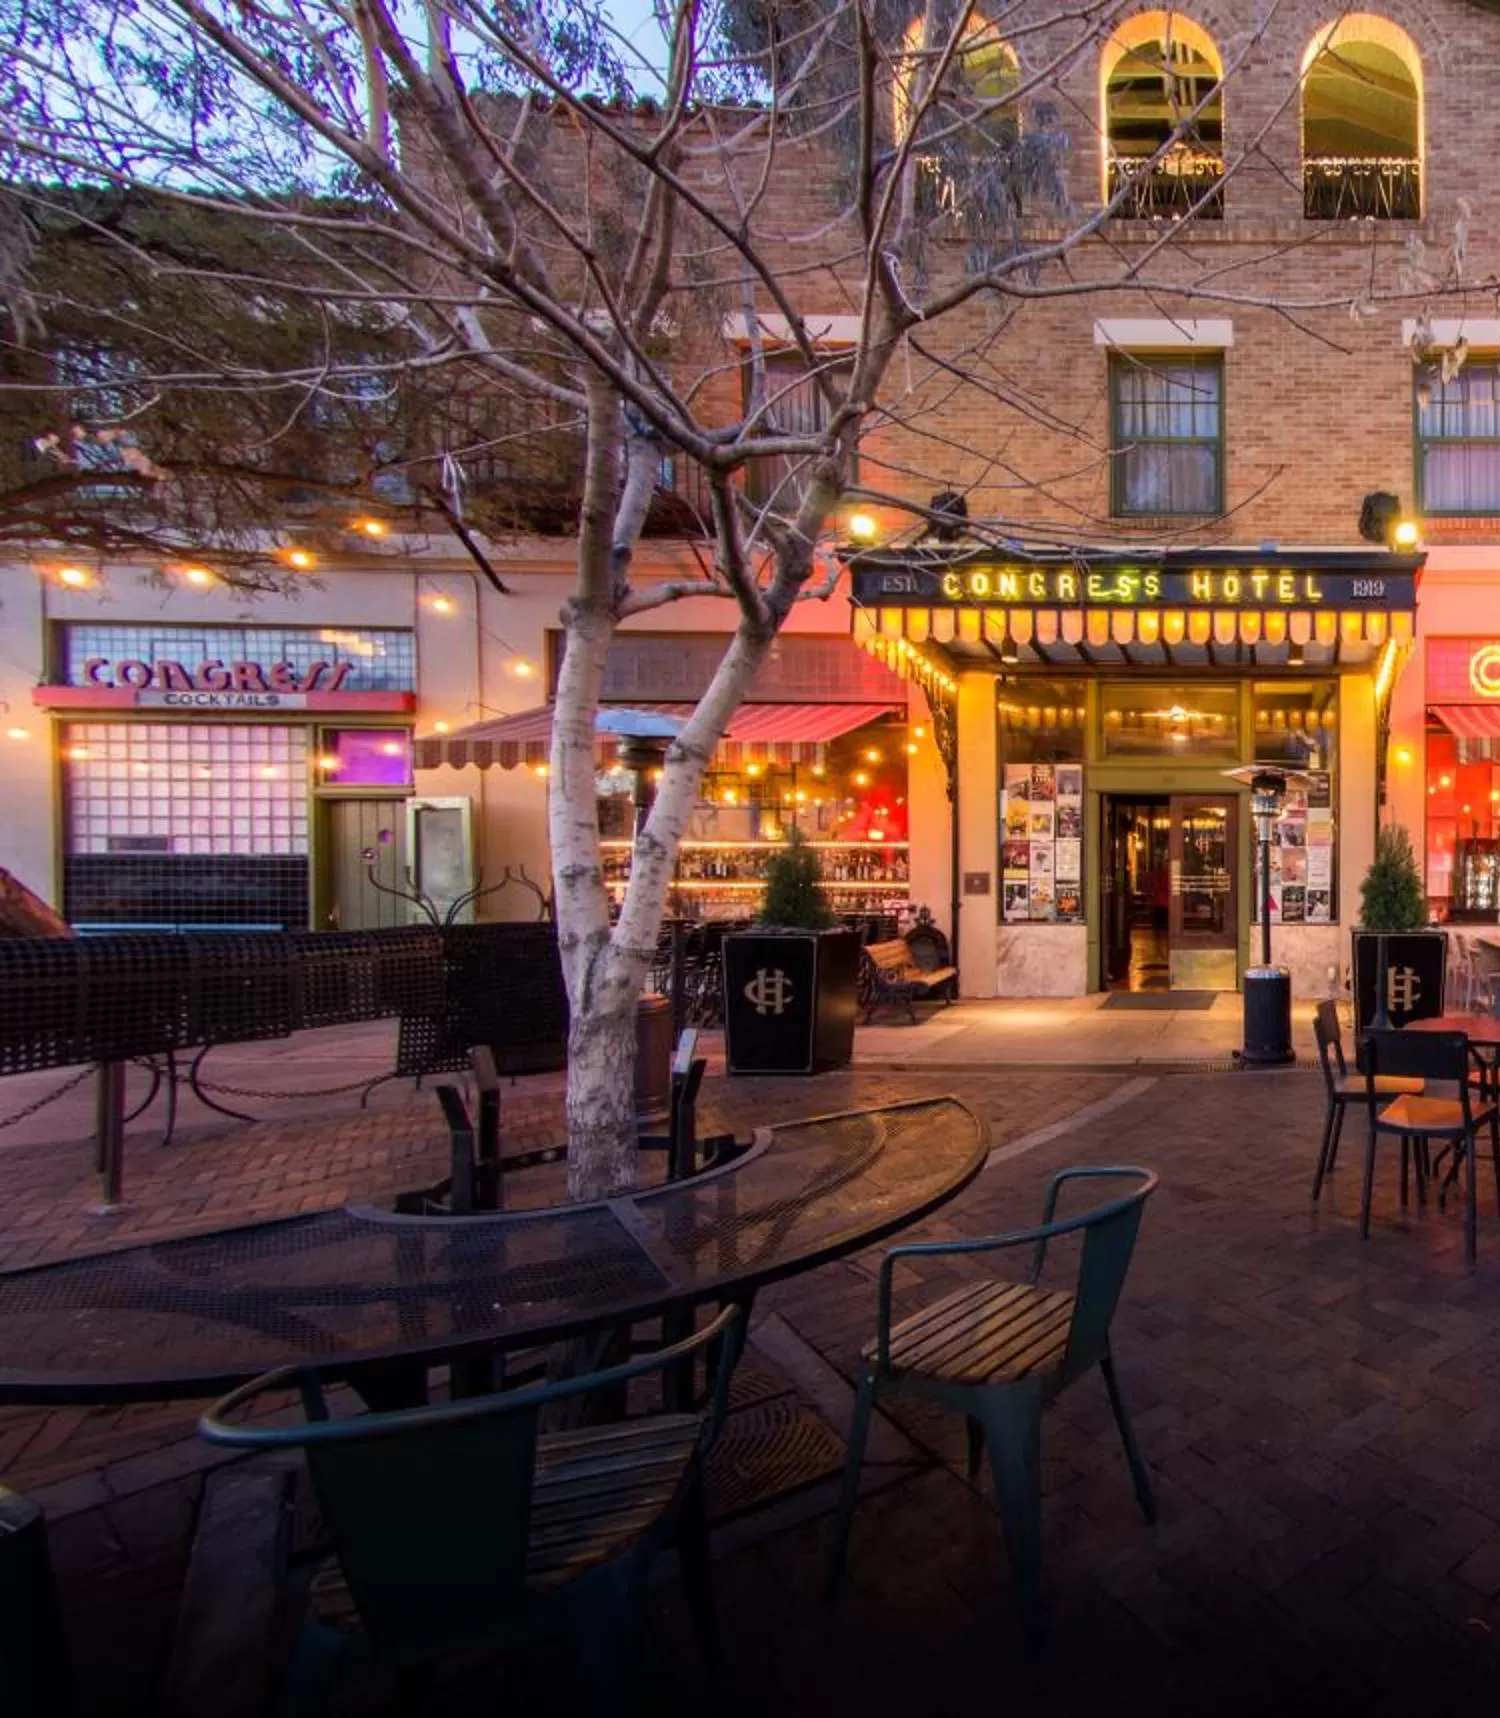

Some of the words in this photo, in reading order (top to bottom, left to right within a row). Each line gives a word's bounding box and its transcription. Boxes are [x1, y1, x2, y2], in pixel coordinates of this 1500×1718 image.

[942, 572, 1161, 599] CONGRESS
[1191, 572, 1323, 601] HOTEL
[1353, 579, 1385, 597] 1919
[83, 658, 354, 692] CONGRESS
[163, 693, 280, 706] COCKTAILS
